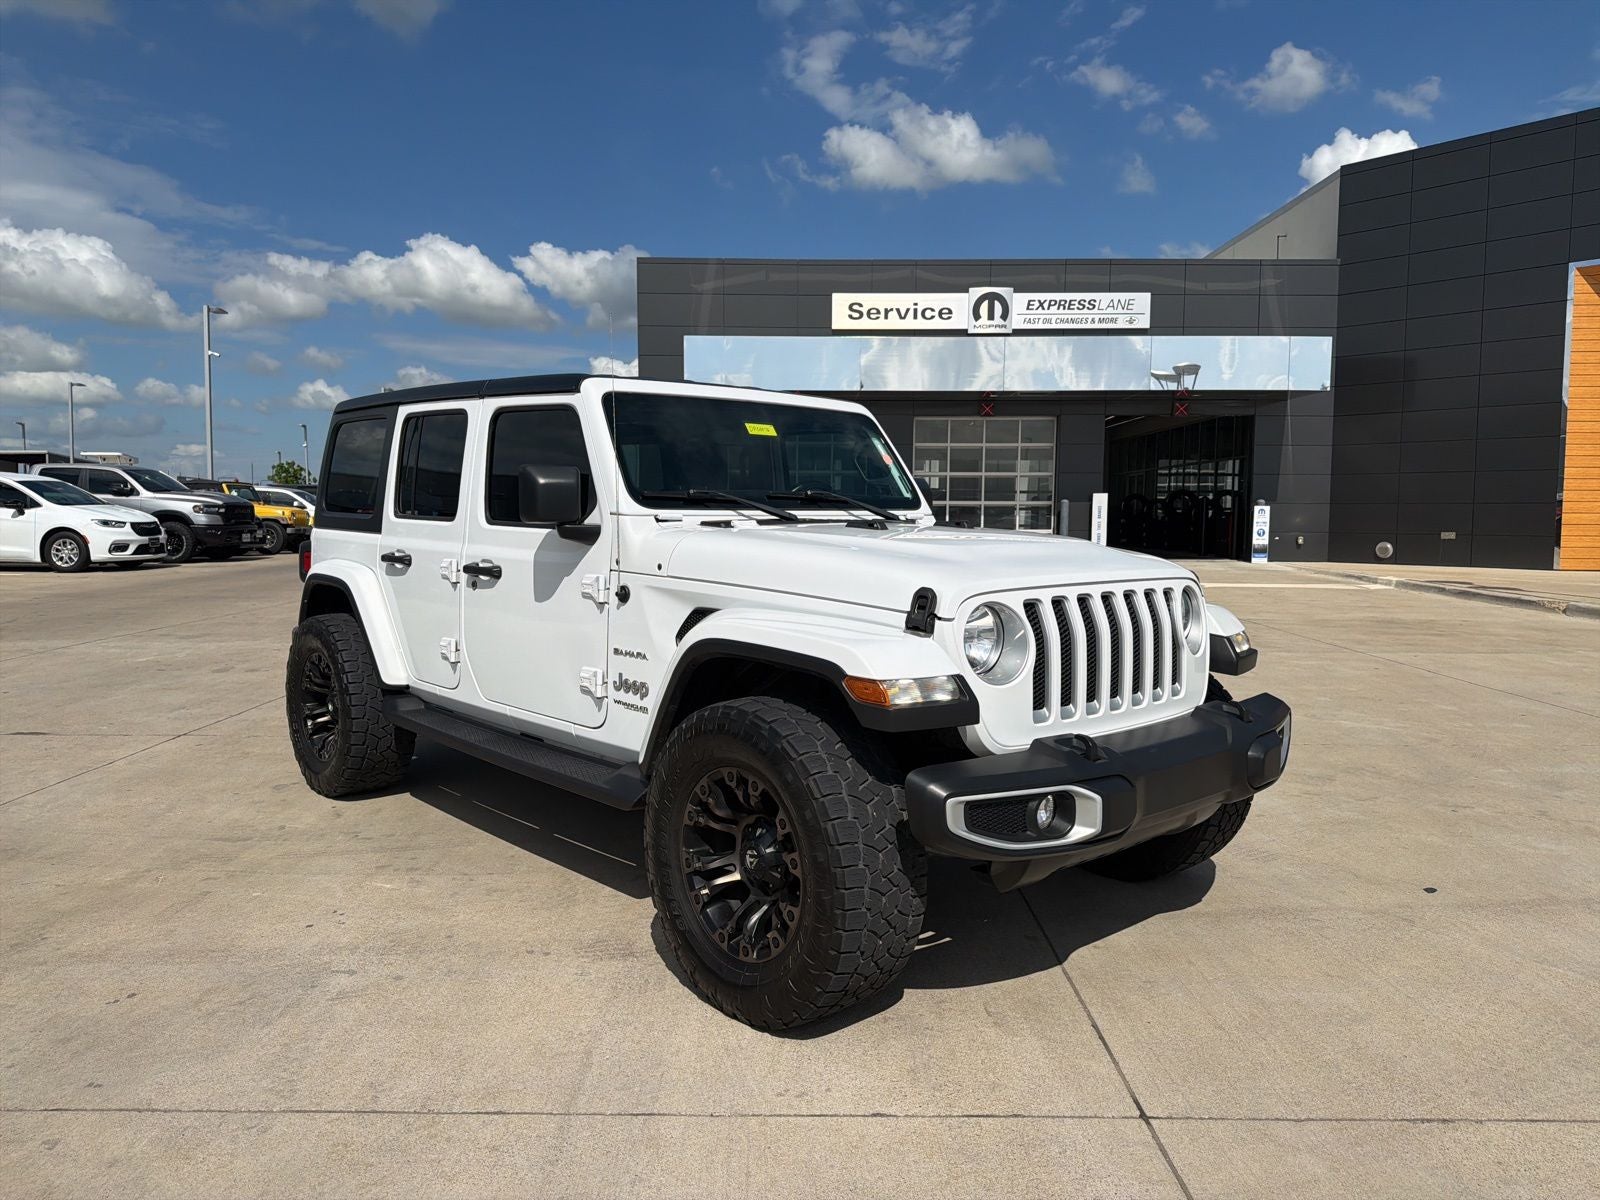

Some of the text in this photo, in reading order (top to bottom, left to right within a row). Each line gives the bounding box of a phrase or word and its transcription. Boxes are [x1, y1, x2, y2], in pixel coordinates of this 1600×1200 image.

[847, 302, 953, 320] Service
[1022, 317, 1119, 325] FAST OIL CHANGES & MORE
[613, 647, 649, 661] SAHARA
[612, 672, 650, 701] Jeep
[613, 698, 649, 712] WRANGLER
